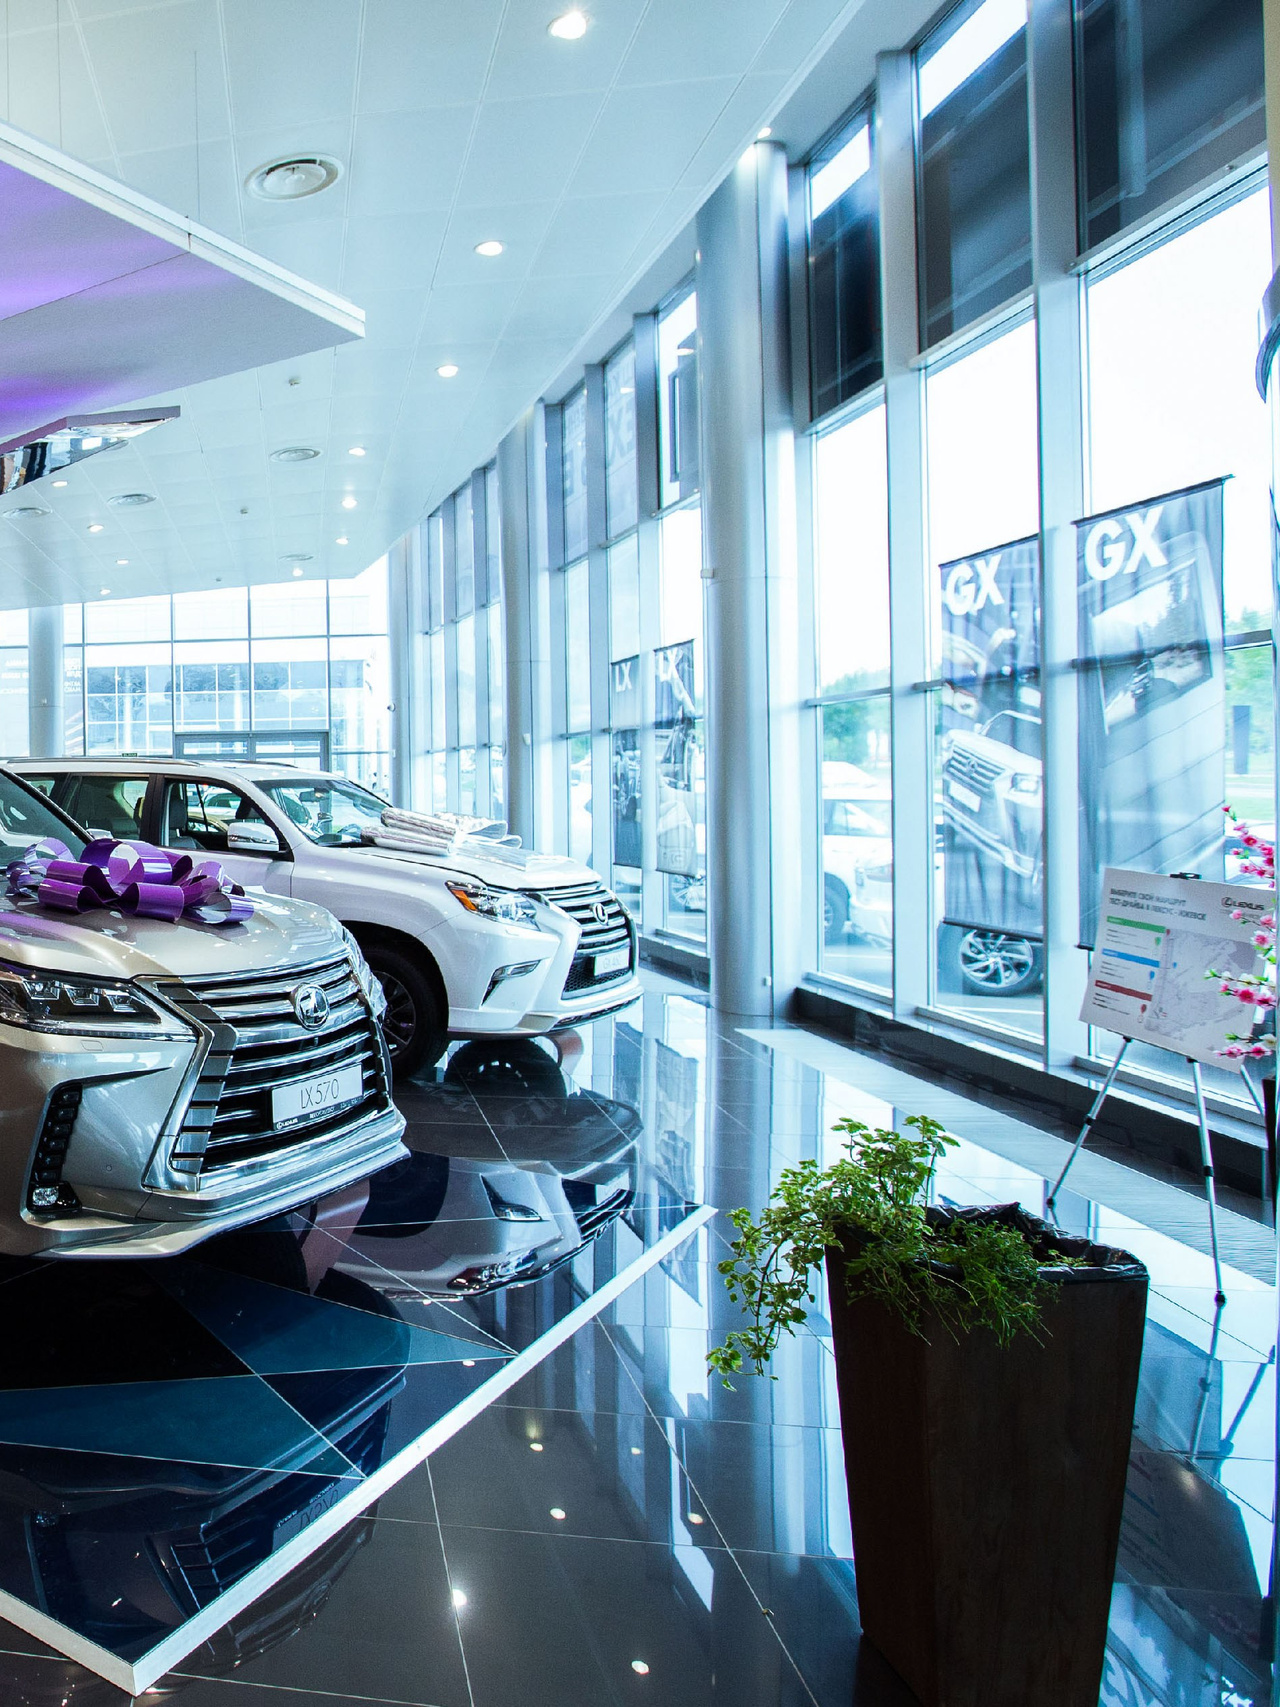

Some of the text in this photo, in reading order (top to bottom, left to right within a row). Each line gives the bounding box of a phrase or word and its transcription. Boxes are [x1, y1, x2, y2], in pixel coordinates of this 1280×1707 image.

[1084, 506, 1168, 581] GX
[946, 554, 1005, 615] GX
[615, 661, 632, 692] LX
[659, 647, 678, 682] LX
[1232, 900, 1265, 910] LEXUS
[300, 1078, 340, 1109] LX 570
